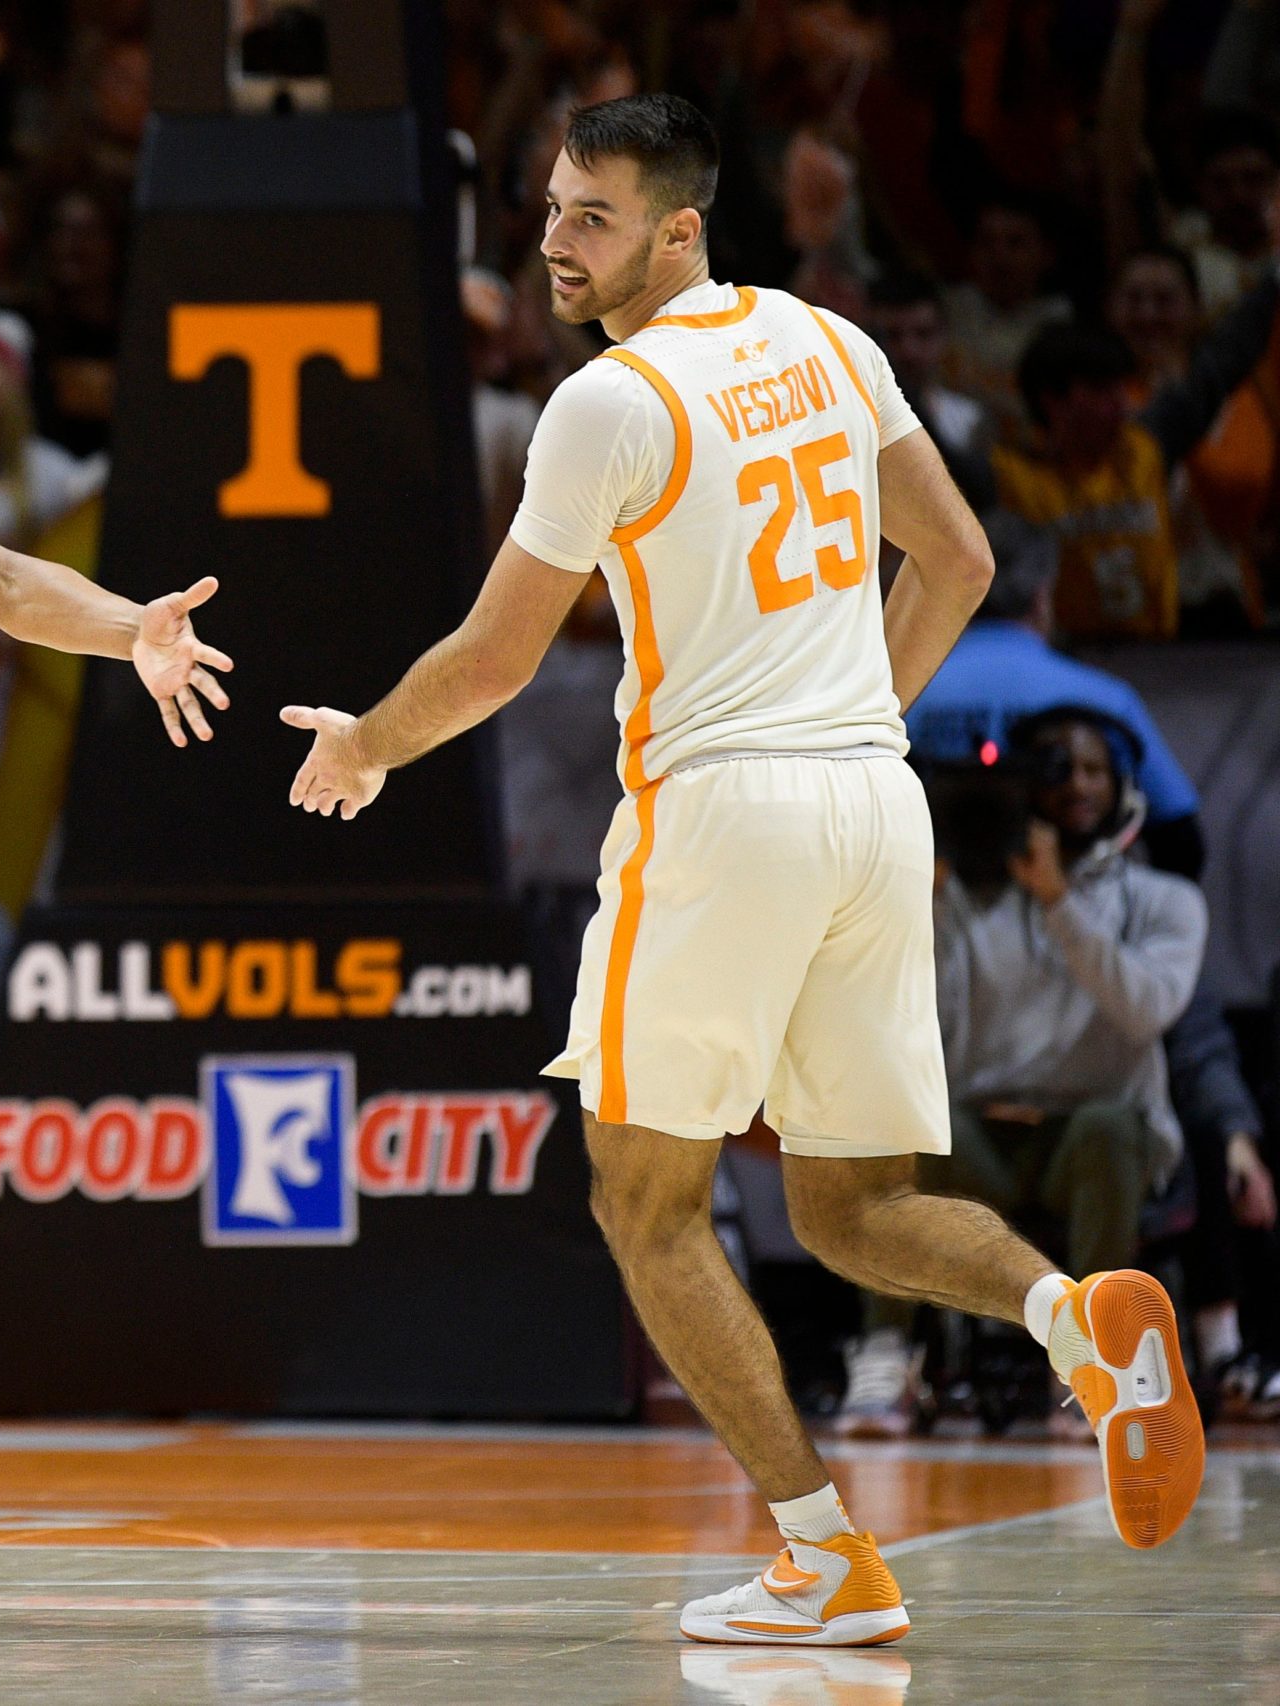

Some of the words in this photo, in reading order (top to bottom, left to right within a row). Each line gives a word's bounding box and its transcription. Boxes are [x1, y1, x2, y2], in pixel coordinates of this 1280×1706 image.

[168, 303, 379, 517] T
[705, 355, 838, 442] VESCOVI
[736, 431, 867, 615] 25
[6, 937, 533, 1021] ALLVOLS.COM
[356, 1090, 557, 1196] CITY
